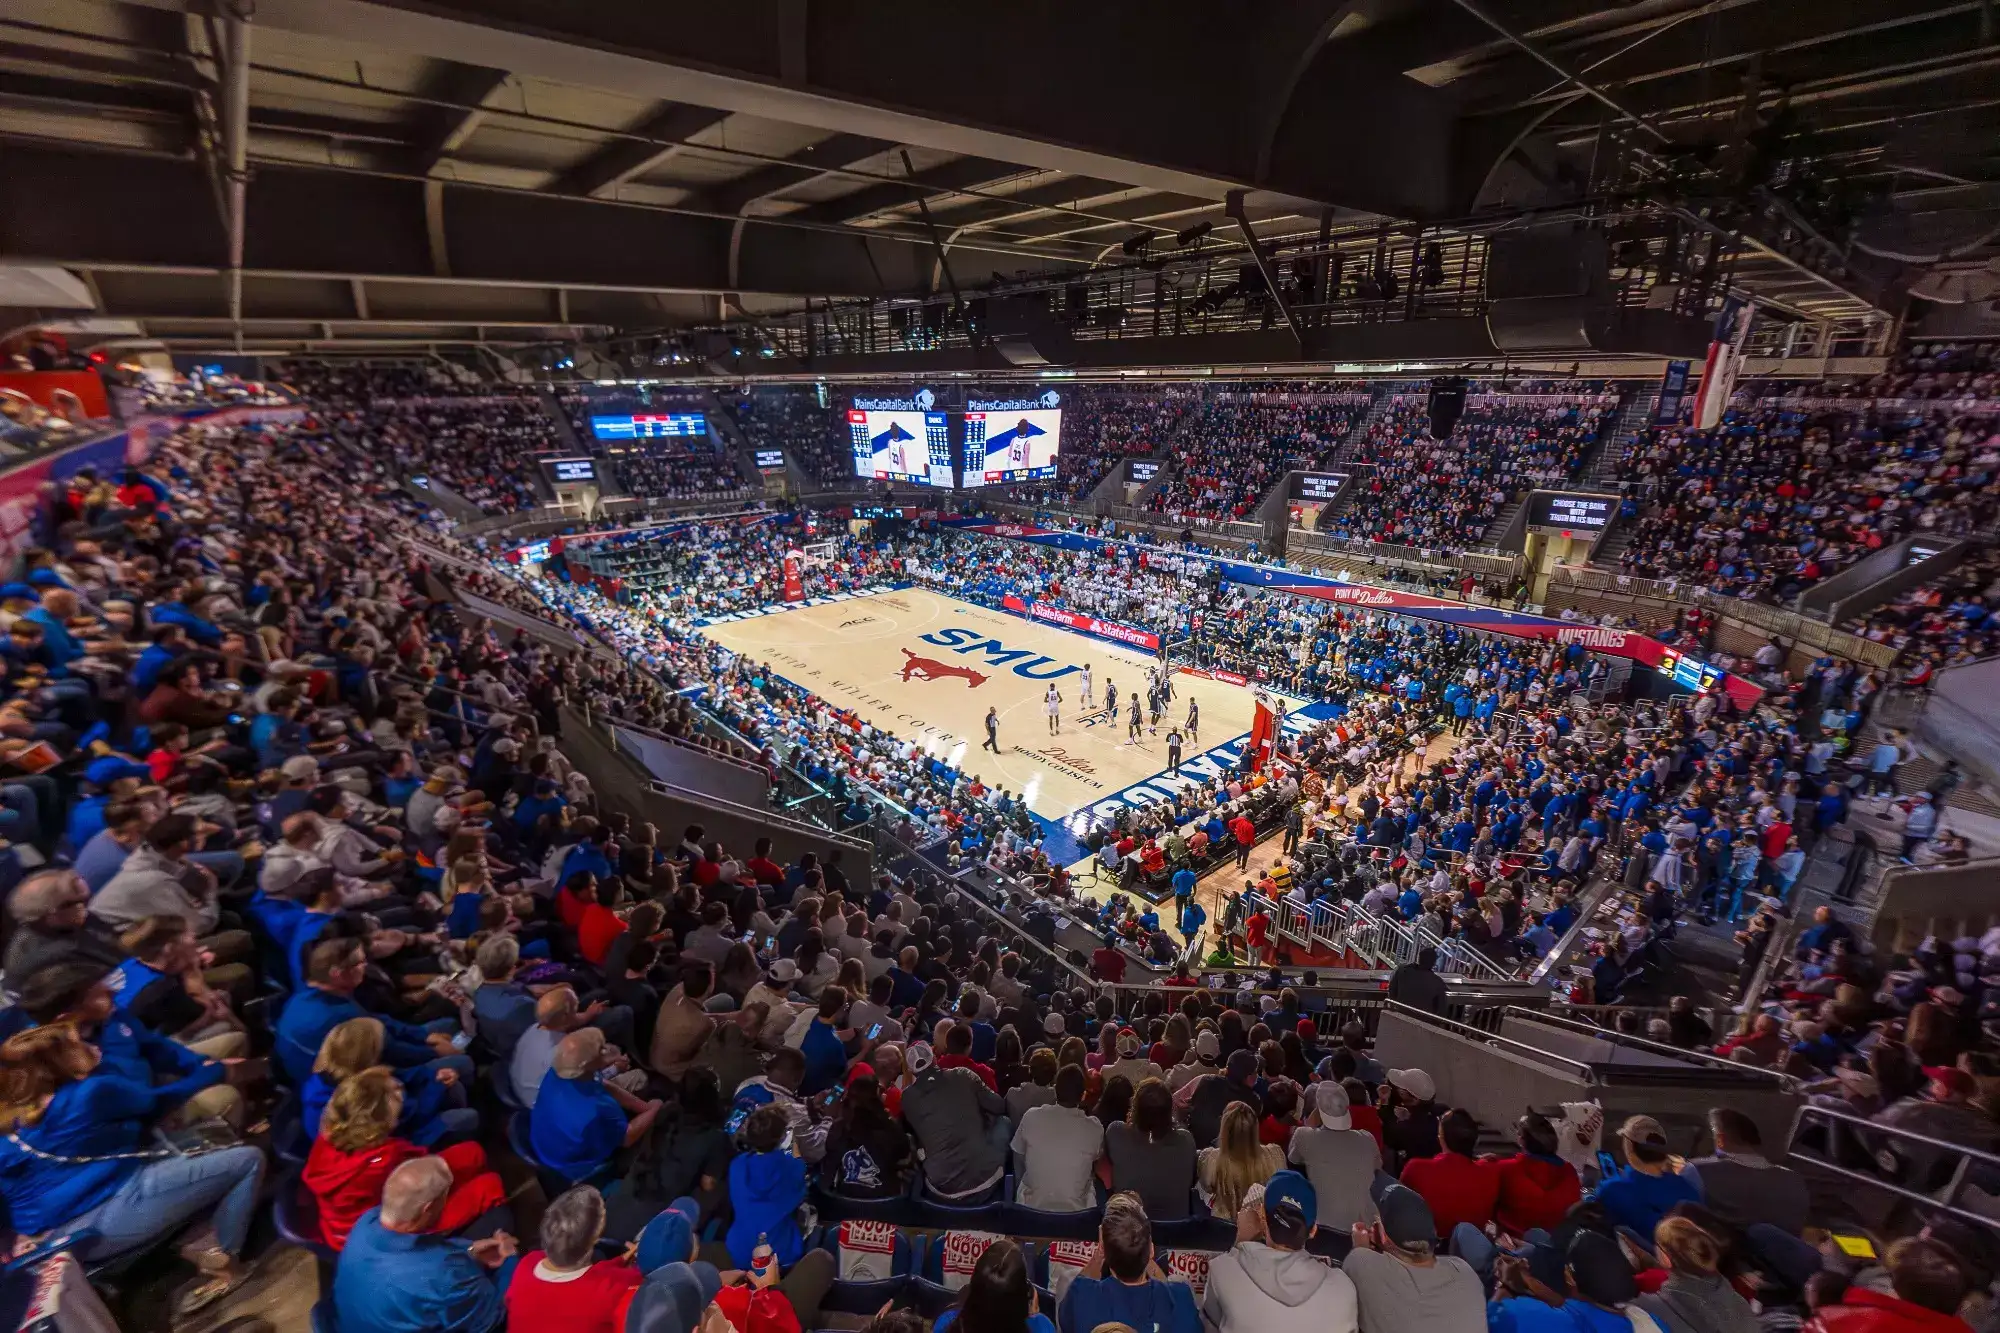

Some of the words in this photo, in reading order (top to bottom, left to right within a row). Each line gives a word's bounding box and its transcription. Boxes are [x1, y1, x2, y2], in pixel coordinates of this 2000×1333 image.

[1552, 499, 1576, 508] CHOOSE
[1576, 500, 1589, 509] THE
[1589, 502, 1607, 510] BANK
[1569, 508, 1586, 516] WITH
[1549, 513, 1569, 521] TRUTH
[1586, 517, 1606, 525] NAME
[1335, 588, 1352, 598] PONY
[1352, 589, 1360, 599] UP
[1357, 591, 1394, 604] Dallas
[1557, 628, 1626, 648] MUSTANGS
[917, 628, 1084, 680] SMU
[763, 647, 807, 669] DAVID
[828, 679, 893, 712] MILLER
[898, 713, 968, 748] COURT
[1012, 745, 1046, 764] MOODY
[1048, 762, 1104, 788] COLISEUM
[1038, 747, 1097, 774] Dallas
[1168, 1252, 1209, 1275] OODY
